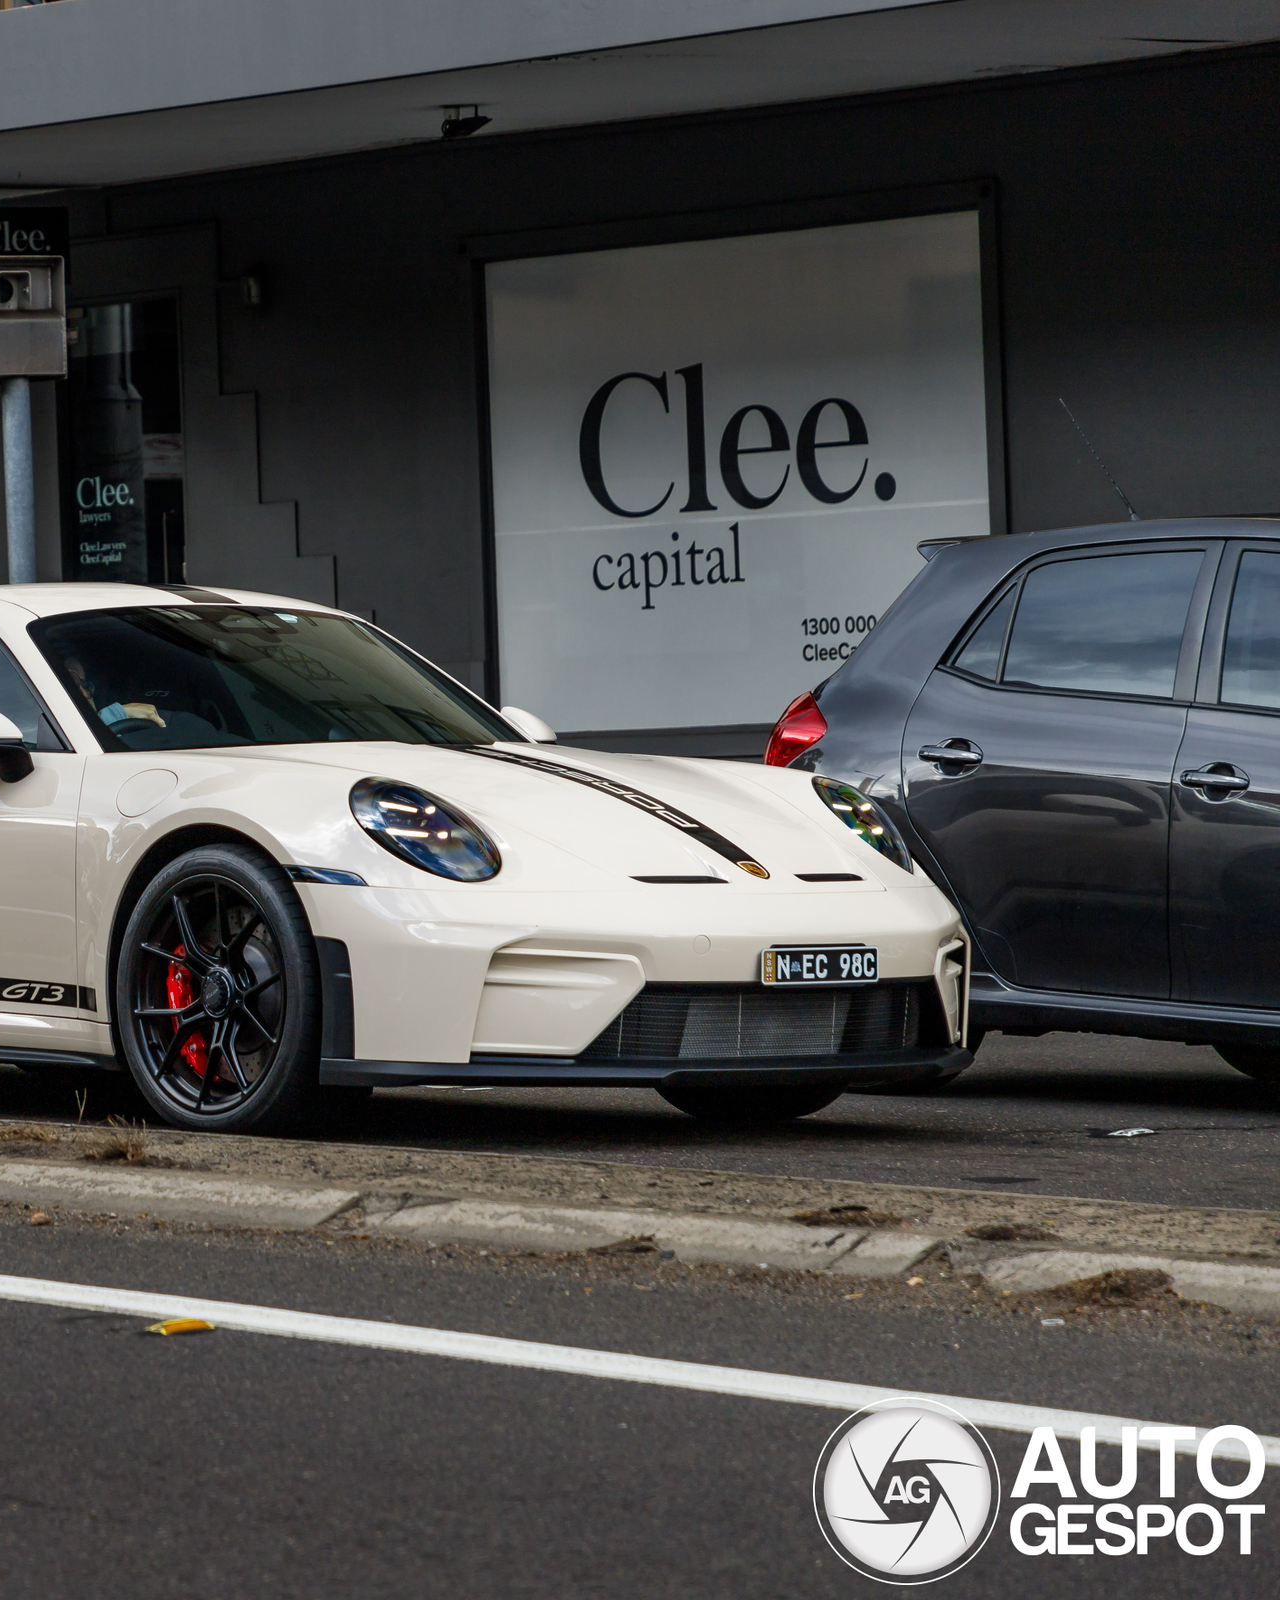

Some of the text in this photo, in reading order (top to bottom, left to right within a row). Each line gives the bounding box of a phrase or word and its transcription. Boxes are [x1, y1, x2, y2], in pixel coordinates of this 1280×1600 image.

[578, 362, 897, 519] Clee.
[76, 476, 135, 508] Clee.
[79, 509, 112, 526] lawyers
[593, 522, 746, 609] capital
[801, 614, 877, 636] 1300 000
[464, 746, 700, 829] PORSCHE
[802, 953, 829, 980] EC
[839, 952, 875, 979] 98C
[1, 982, 65, 1003] GT3
